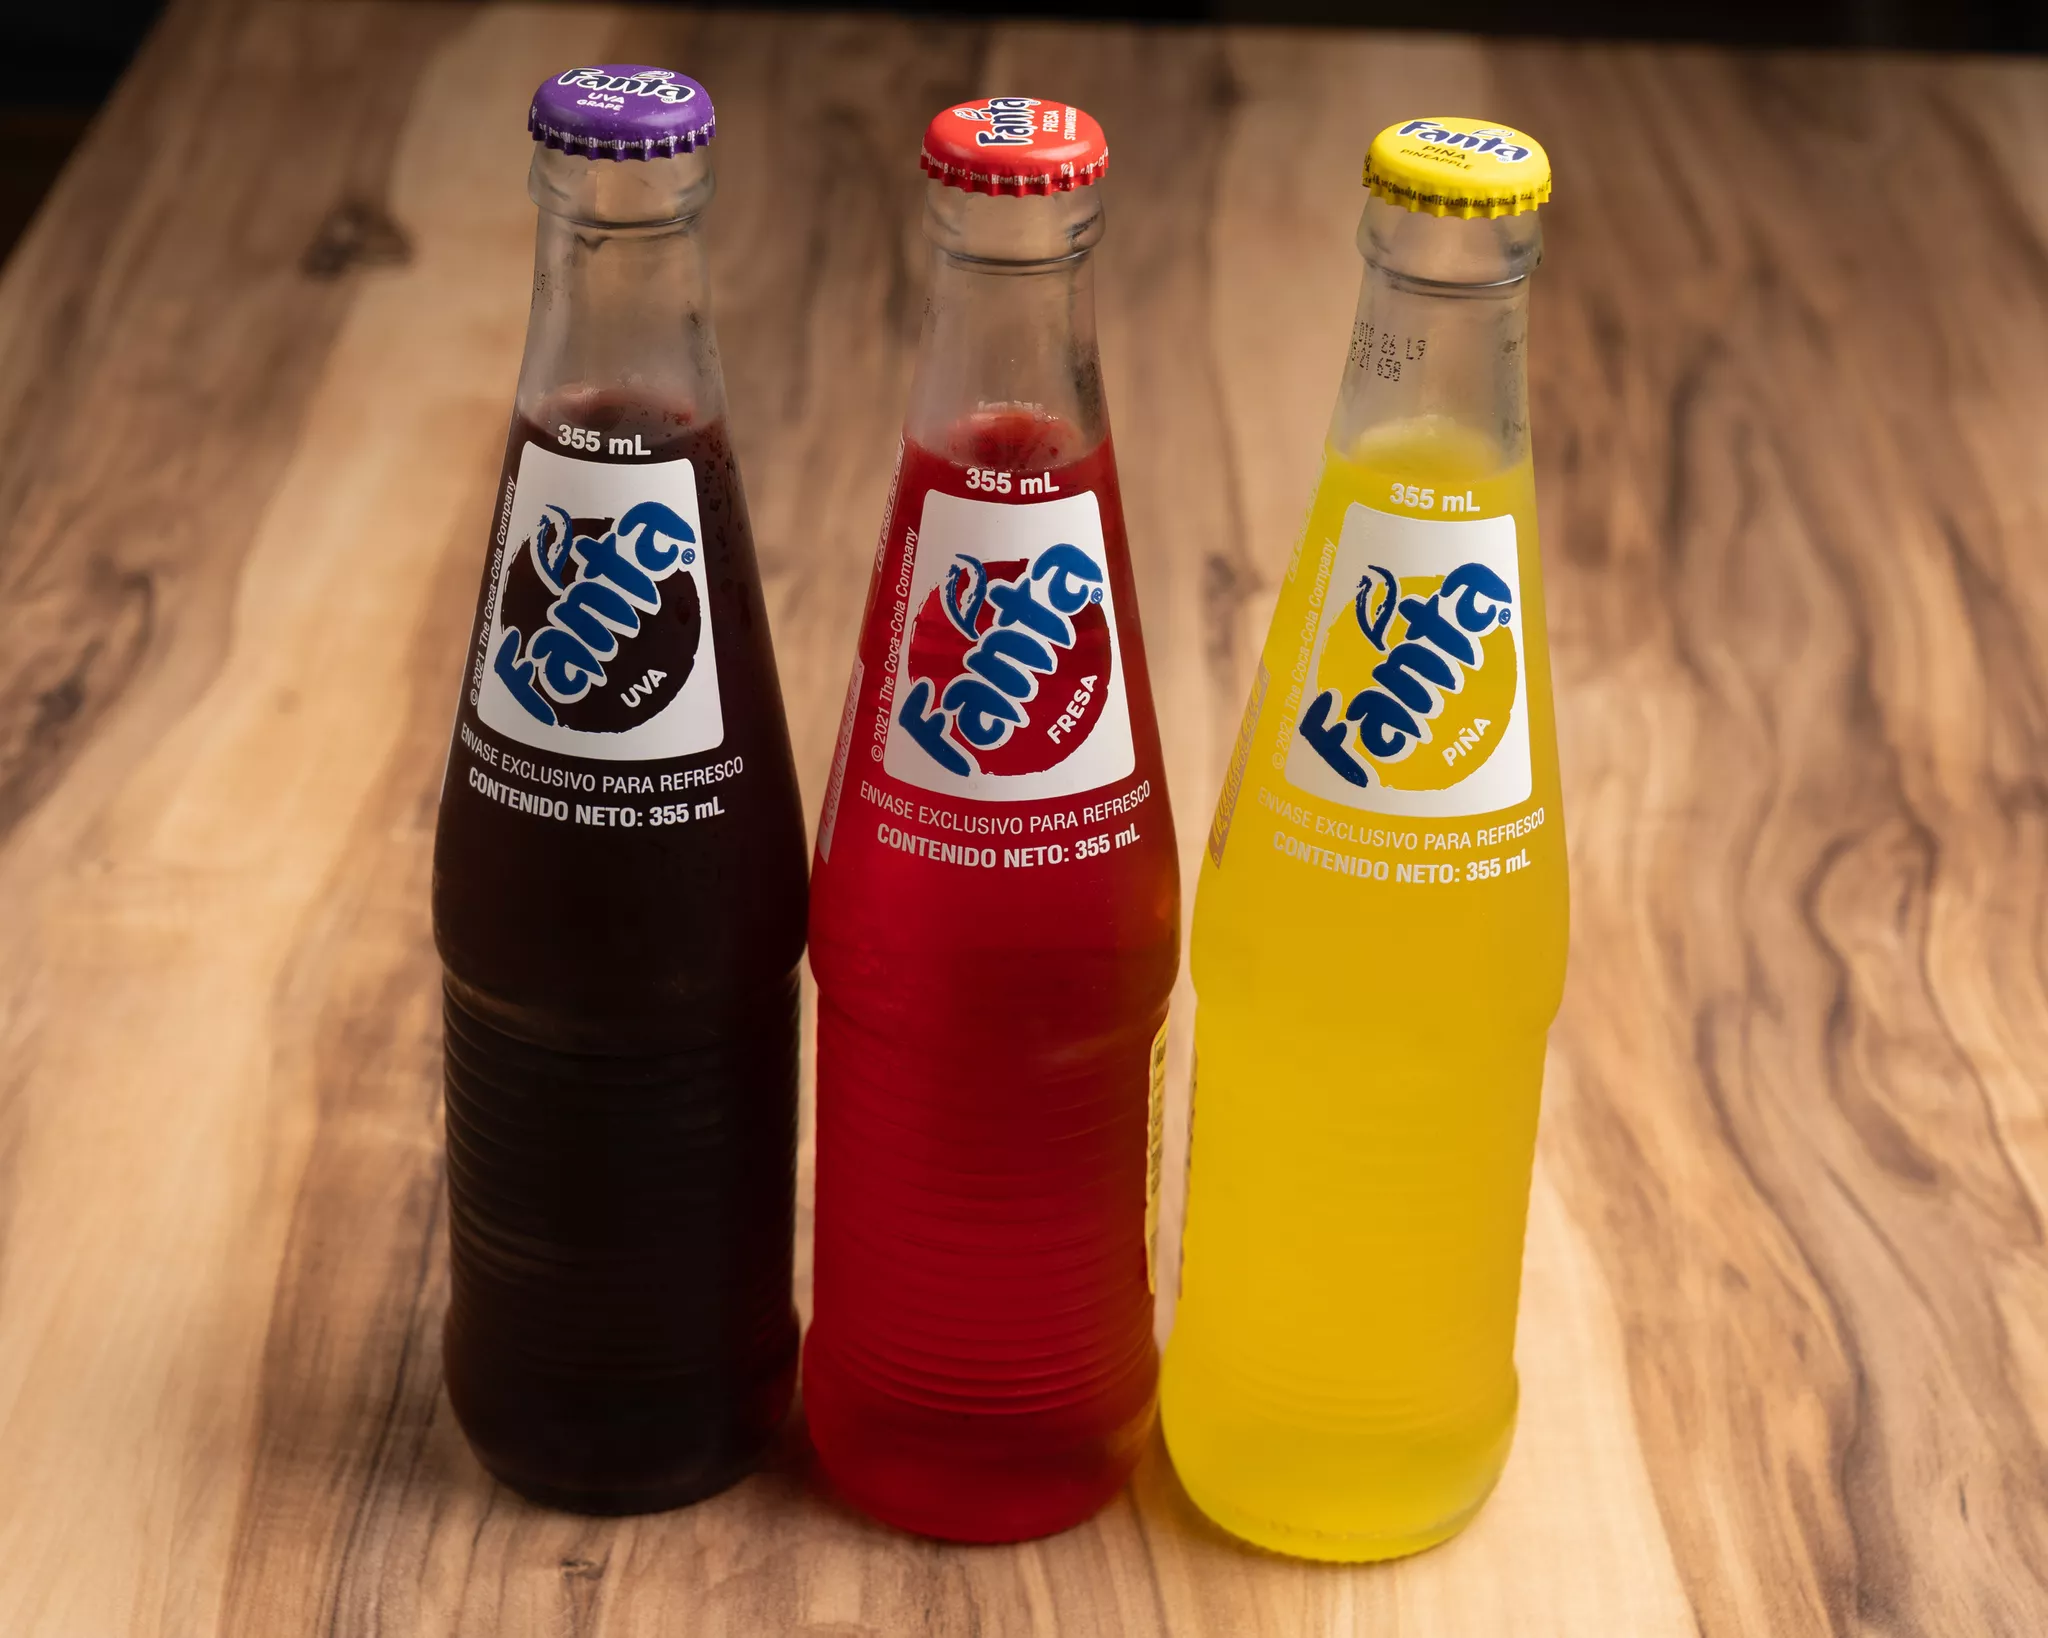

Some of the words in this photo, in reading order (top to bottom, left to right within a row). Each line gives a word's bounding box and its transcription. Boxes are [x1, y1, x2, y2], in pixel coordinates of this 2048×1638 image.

[558, 68, 695, 103] Fanta
[577, 99, 624, 111] GRAPE
[588, 92, 625, 104] UVA
[976, 98, 1038, 146] Fanta
[1043, 110, 1059, 132] FRESA
[1064, 107, 1076, 140] STRAWBERRY
[1398, 121, 1531, 161] Fanta
[1400, 149, 1475, 170] PINEAPPLE
[1423, 145, 1466, 160] PIÑA
[558, 424, 600, 452] 355
[609, 435, 651, 455] mL
[965, 467, 1012, 494] 355
[1020, 472, 1060, 495] mL
[1390, 482, 1435, 510] 355
[1442, 491, 1480, 513] mL
[497, 476, 516, 546] Company
[895, 526, 918, 598] Company
[1308, 537, 1337, 608] Company
[484, 548, 503, 620] Coca-Cola
[479, 622, 490, 648] The
[494, 501, 696, 726] Fanta
[884, 600, 906, 674] Coca-Cola
[1291, 610, 1319, 683] Coca-Cola
[473, 651, 485, 689] 2021
[898, 543, 1103, 778] Fanta
[1298, 562, 1512, 788] Fanta
[621, 669, 667, 708] UVA
[879, 675, 895, 702] The
[1046, 674, 1098, 745] FRESA
[1284, 685, 1301, 712] The
[874, 706, 890, 745] 2021
[1276, 714, 1296, 752] 2021
[1441, 717, 1491, 767] PIÑA
[461, 722, 499, 767] ENVASE
[501, 754, 596, 792] EXCLUSIVO
[602, 776, 654, 794] PARA
[659, 756, 744, 792] REFRESCO
[469, 767, 569, 821] CONTENIDO
[575, 804, 643, 827] NETO:
[649, 803, 690, 826] 355
[695, 796, 725, 820] mL
[860, 780, 914, 820] ENVASE
[918, 805, 1024, 835] EXCLUSIVO
[1029, 811, 1079, 834] PARA
[1083, 779, 1151, 825] REFRESCO
[1257, 786, 1312, 829] ENVASE
[1315, 816, 1418, 850] EXCLUSIVO
[1424, 832, 1471, 850] PARA
[1476, 807, 1545, 847] REFRESCO
[877, 823, 997, 869] CONTENIDO
[1003, 844, 1070, 869] NETO:
[1074, 833, 1111, 861] 355
[1115, 822, 1141, 849] mL
[1273, 831, 1389, 882] CONTENIDO
[1395, 863, 1460, 884] NETO:
[1465, 858, 1501, 882] 355
[1505, 848, 1531, 874] mL
